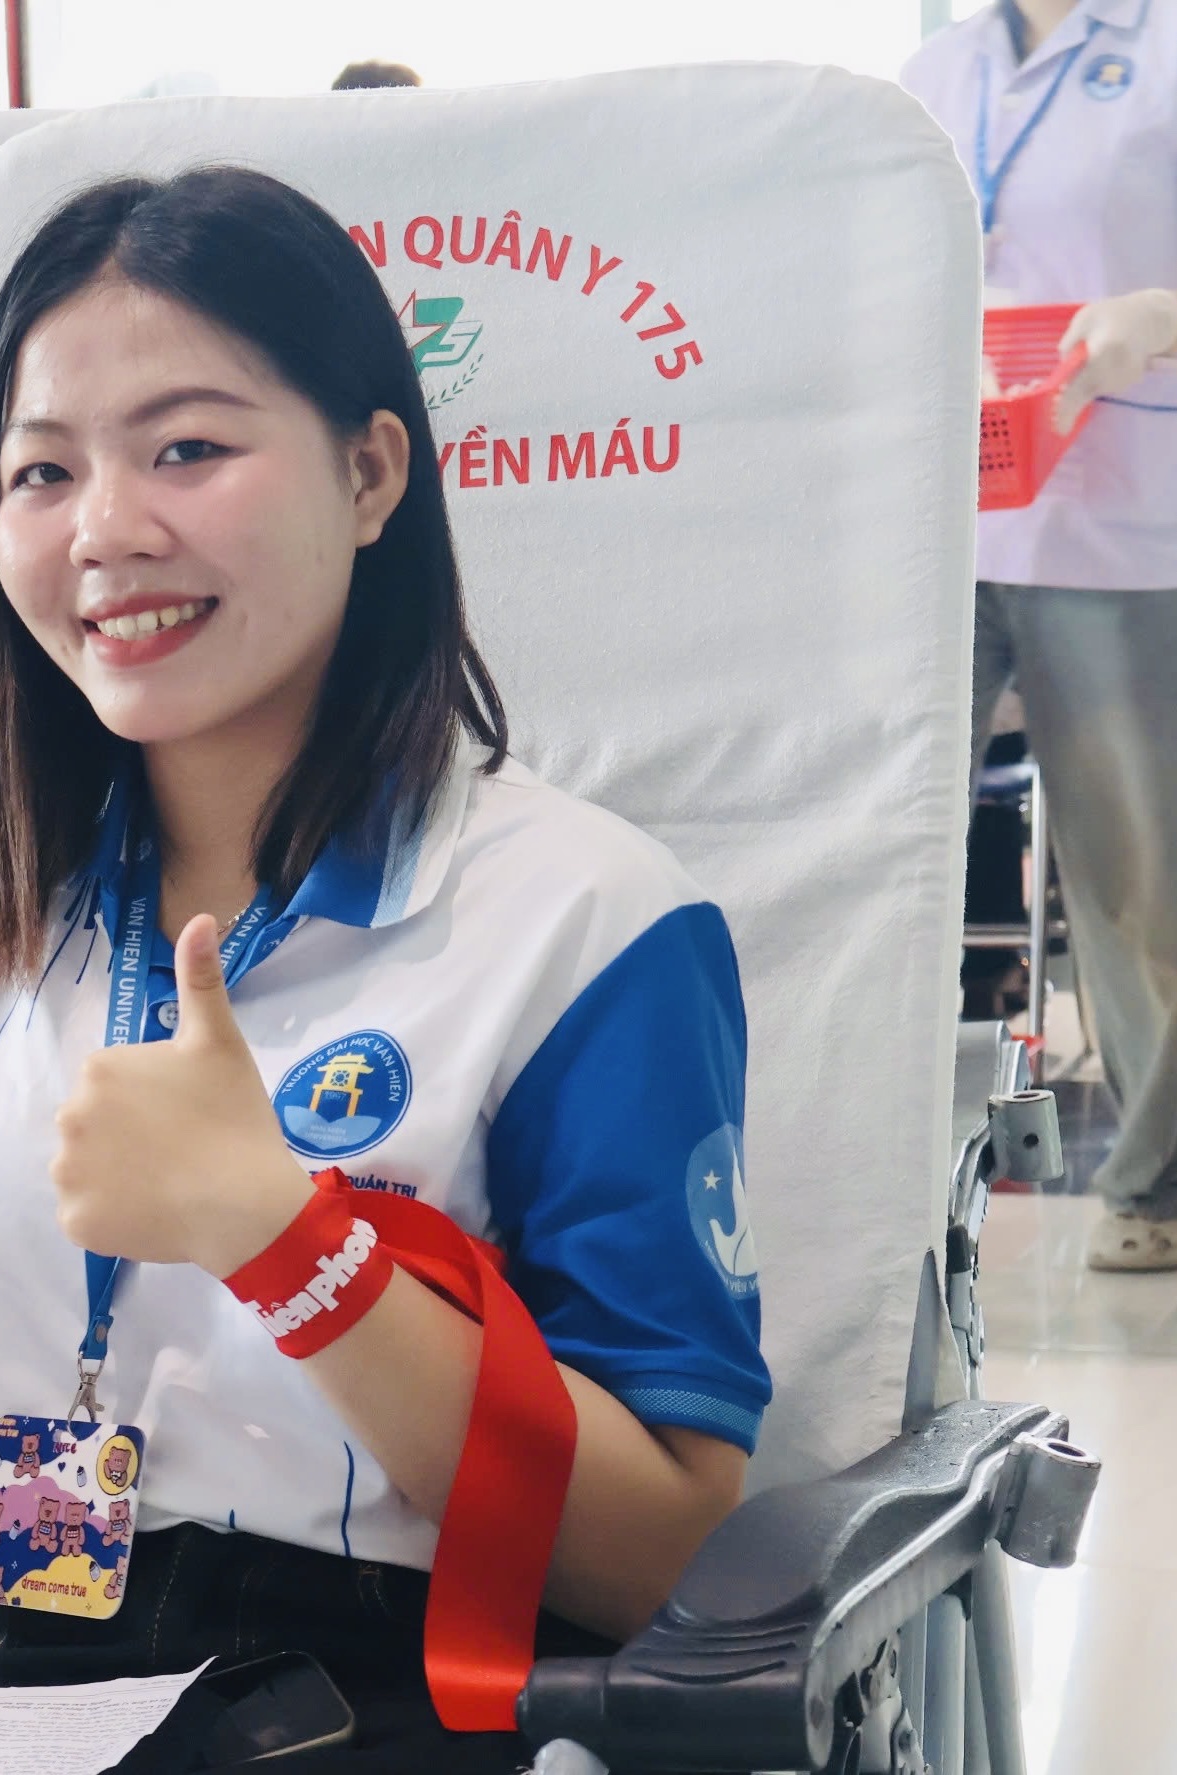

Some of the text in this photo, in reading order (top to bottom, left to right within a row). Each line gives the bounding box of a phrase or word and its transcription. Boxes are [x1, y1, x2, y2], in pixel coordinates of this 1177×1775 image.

[404, 209, 573, 281] QUÂN
[581, 245, 624, 297] Y
[620, 280, 704, 380] 175
[547, 417, 680, 482] MÁU
[131, 897, 147, 928] VAN
[235, 906, 268, 938] VAN
[122, 930, 143, 972] HIEN
[21, 1576, 87, 1597] dream come true
